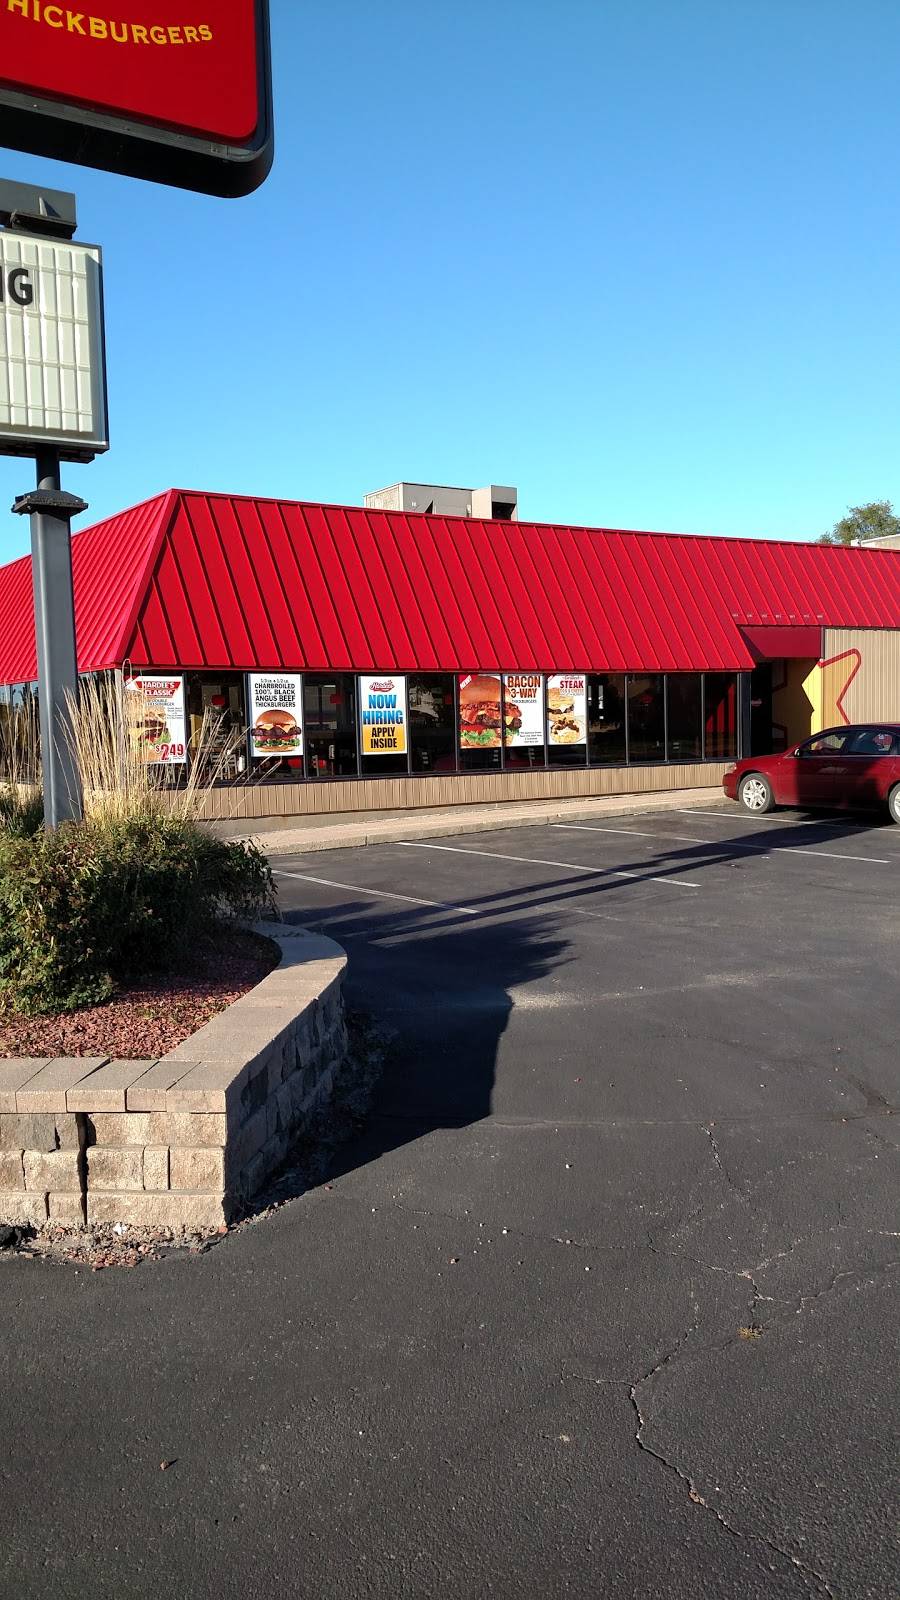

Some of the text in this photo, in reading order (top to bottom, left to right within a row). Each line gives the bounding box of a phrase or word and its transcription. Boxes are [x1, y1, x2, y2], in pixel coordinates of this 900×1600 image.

[0, 266, 34, 306] G
[507, 675, 541, 688] BACON
[560, 680, 584, 689] STEAK
[511, 688, 537, 698] 3-WAY
[368, 694, 397, 709] NOW
[362, 709, 404, 725] HIRING
[371, 727, 396, 738] APPLY
[370, 738, 398, 749] INSIDE
